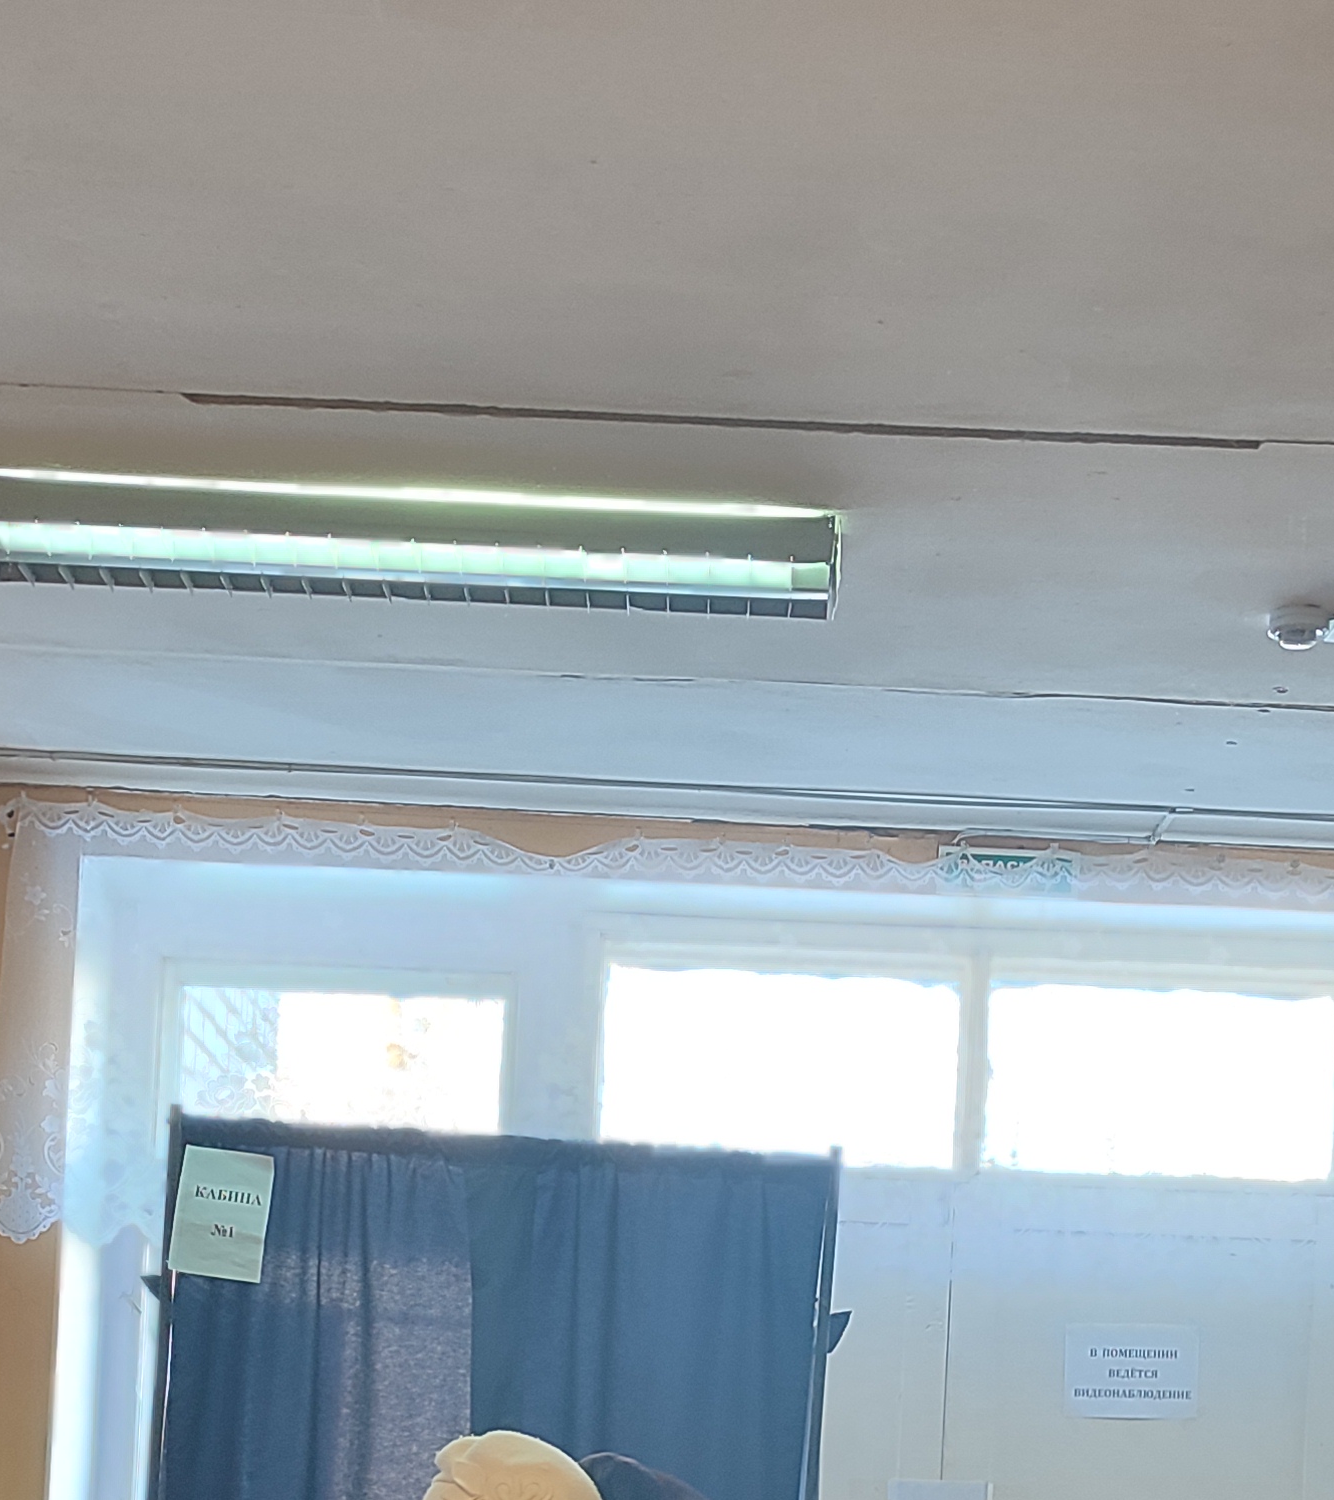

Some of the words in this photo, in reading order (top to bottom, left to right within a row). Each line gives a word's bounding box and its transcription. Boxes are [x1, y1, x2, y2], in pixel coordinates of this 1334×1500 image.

[195, 1185, 262, 1206] КАБИНА
[210, 1223, 234, 1238] №1
[1090, 1347, 1098, 1358] В
[1102, 1348, 1178, 1360] ПОМЕЩЕНИИ
[1108, 1367, 1158, 1379] ВЕДЁТСЯ
[1074, 1388, 1192, 1400] ВИДЕОНАБЛЮДЕНИЕ
